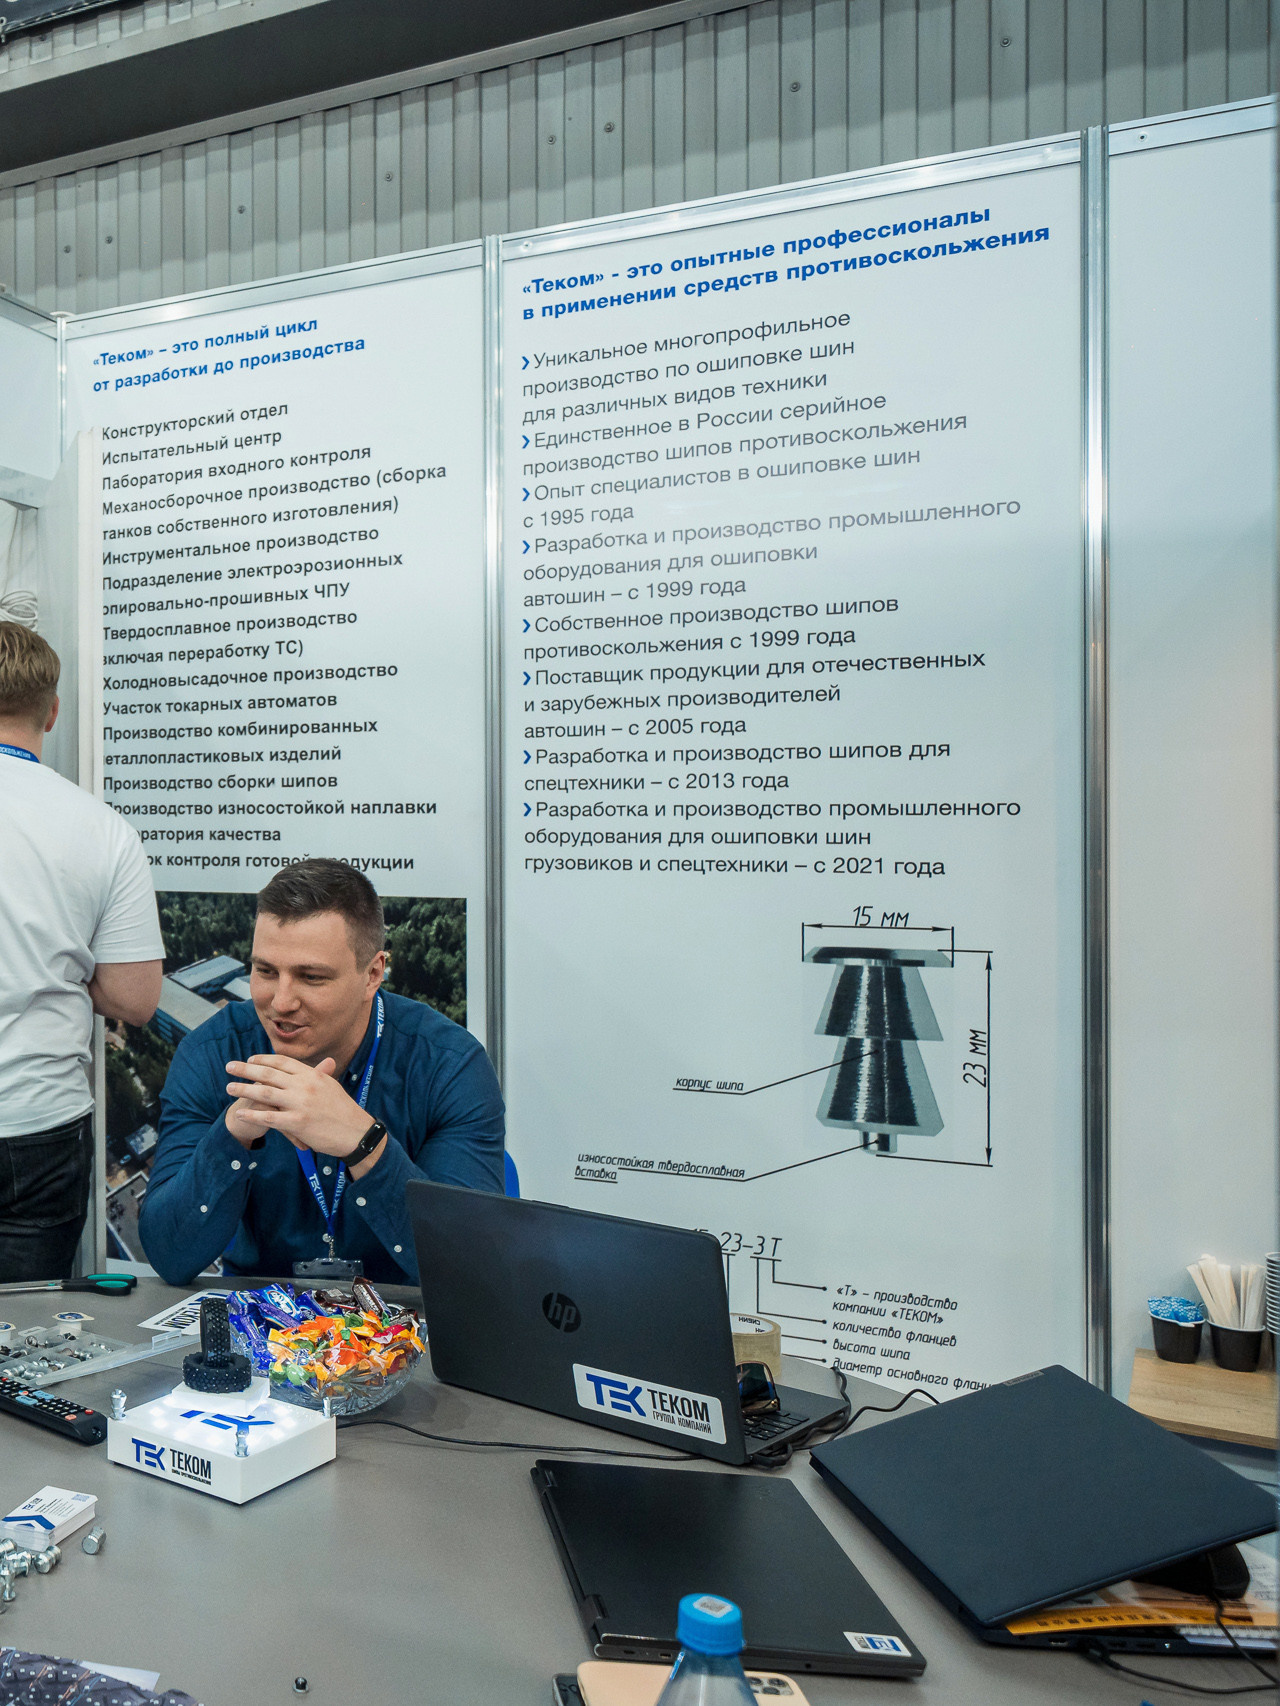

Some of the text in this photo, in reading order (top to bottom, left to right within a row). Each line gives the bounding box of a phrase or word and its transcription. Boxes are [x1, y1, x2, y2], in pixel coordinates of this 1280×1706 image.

[522, 207, 991, 294] «Теком» это опытные профессионалы
[522, 227, 1050, 321] в применении средств противоскольжения
[92, 319, 318, 366] «Теком» это полный цикл
[533, 313, 851, 369] Уникальное многопрофильное
[92, 338, 365, 393] от разработки до производства
[102, 403, 289, 441] Конструкторский отдел
[534, 395, 887, 450] Единственное в России серийное
[102, 431, 283, 466] Испытательный центр
[208, 457, 285, 478] входного
[290, 447, 371, 468] контроля
[523, 415, 967, 479] производство шипов противоскольжения
[102, 466, 447, 516] Механосборочное производство (сборка
[534, 449, 921, 501] Опыт специалистов в ошиповке шин
[156, 513, 268, 535] собственного
[272, 495, 399, 523] изготовления)
[535, 500, 1021, 555] Разработка и производство промышленного
[102, 528, 380, 566] Инструментальное производство
[102, 581, 351, 617] опировально-прошивных ЧПУ
[102, 612, 358, 643] Твердосплавное производство
[102, 665, 399, 691] Холодновысадочное производство
[535, 653, 986, 686] Поставщик продукции для отечественных
[524, 683, 841, 715] и зарубежных производителей
[103, 745, 342, 766] еталлопластиковых изделий
[103, 773, 339, 794] Производство сборки шипов
[524, 772, 790, 794] спецтехники с 2013 года
[218, 799, 345, 815] износостойкой
[350, 802, 437, 815] наплавки
[853, 905, 909, 928] 15 мм
[963, 1029, 987, 1087] 23 мм
[675, 1076, 745, 1093] корпус шипа
[575, 1166, 617, 1181] вставка
[577, 1153, 745, 1179] износостойкая твердосплавная
[543, 1292, 581, 1333] hp
[832, 1301, 944, 1325] компании «ТЕКОМ»
[836, 1285, 958, 1310] «Т» производство
[832, 1321, 957, 1348] количество фланцев
[832, 1338, 911, 1361] высота шипа
[833, 1357, 883, 1377] диаметр
[886, 1366, 948, 1386] основного
[647, 1388, 711, 1423] ТЕКОМ
[652, 1411, 712, 1434] ГРУППА КОМПАНИЙ
[170, 1448, 212, 1480] ТЕКОМ
